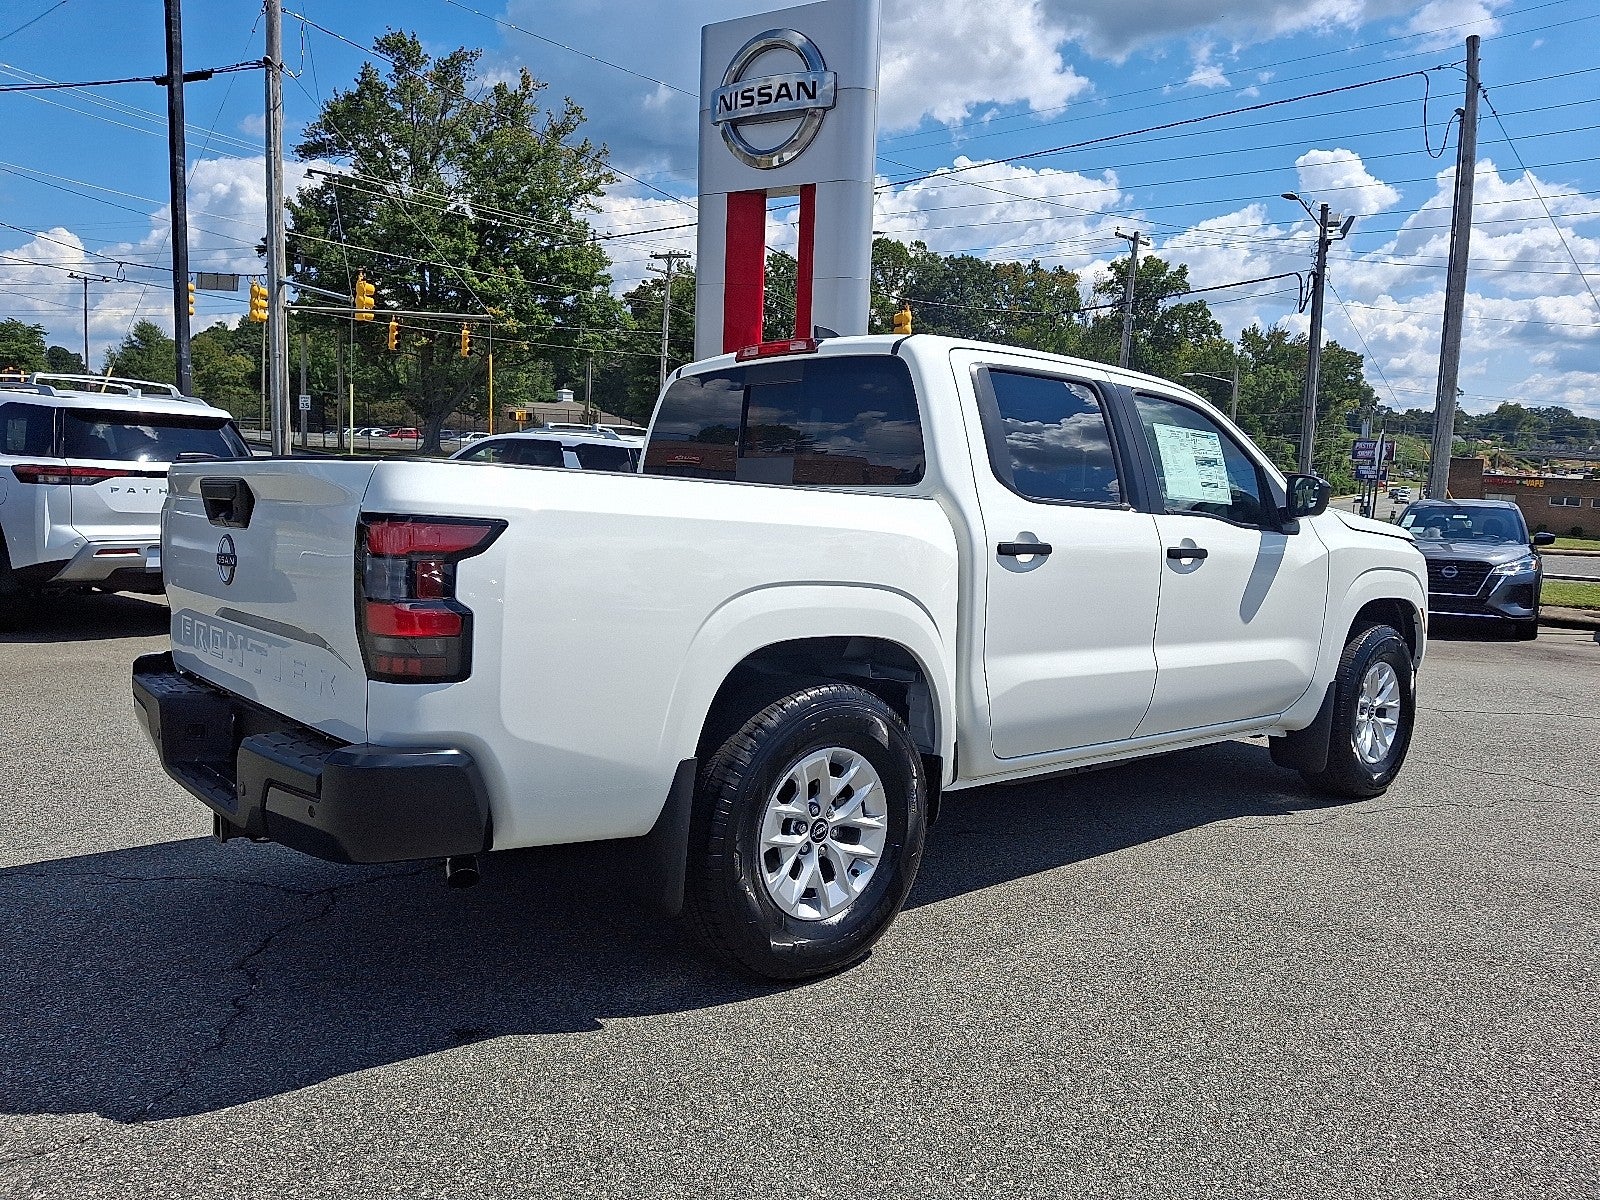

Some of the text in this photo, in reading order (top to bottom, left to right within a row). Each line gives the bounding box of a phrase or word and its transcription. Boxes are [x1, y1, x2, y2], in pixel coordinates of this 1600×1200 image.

[718, 81, 817, 114] NISSAN
[110, 486, 168, 494] PATH
[1525, 479, 1545, 488] VAPE
[181, 614, 337, 697] FRONTIER
